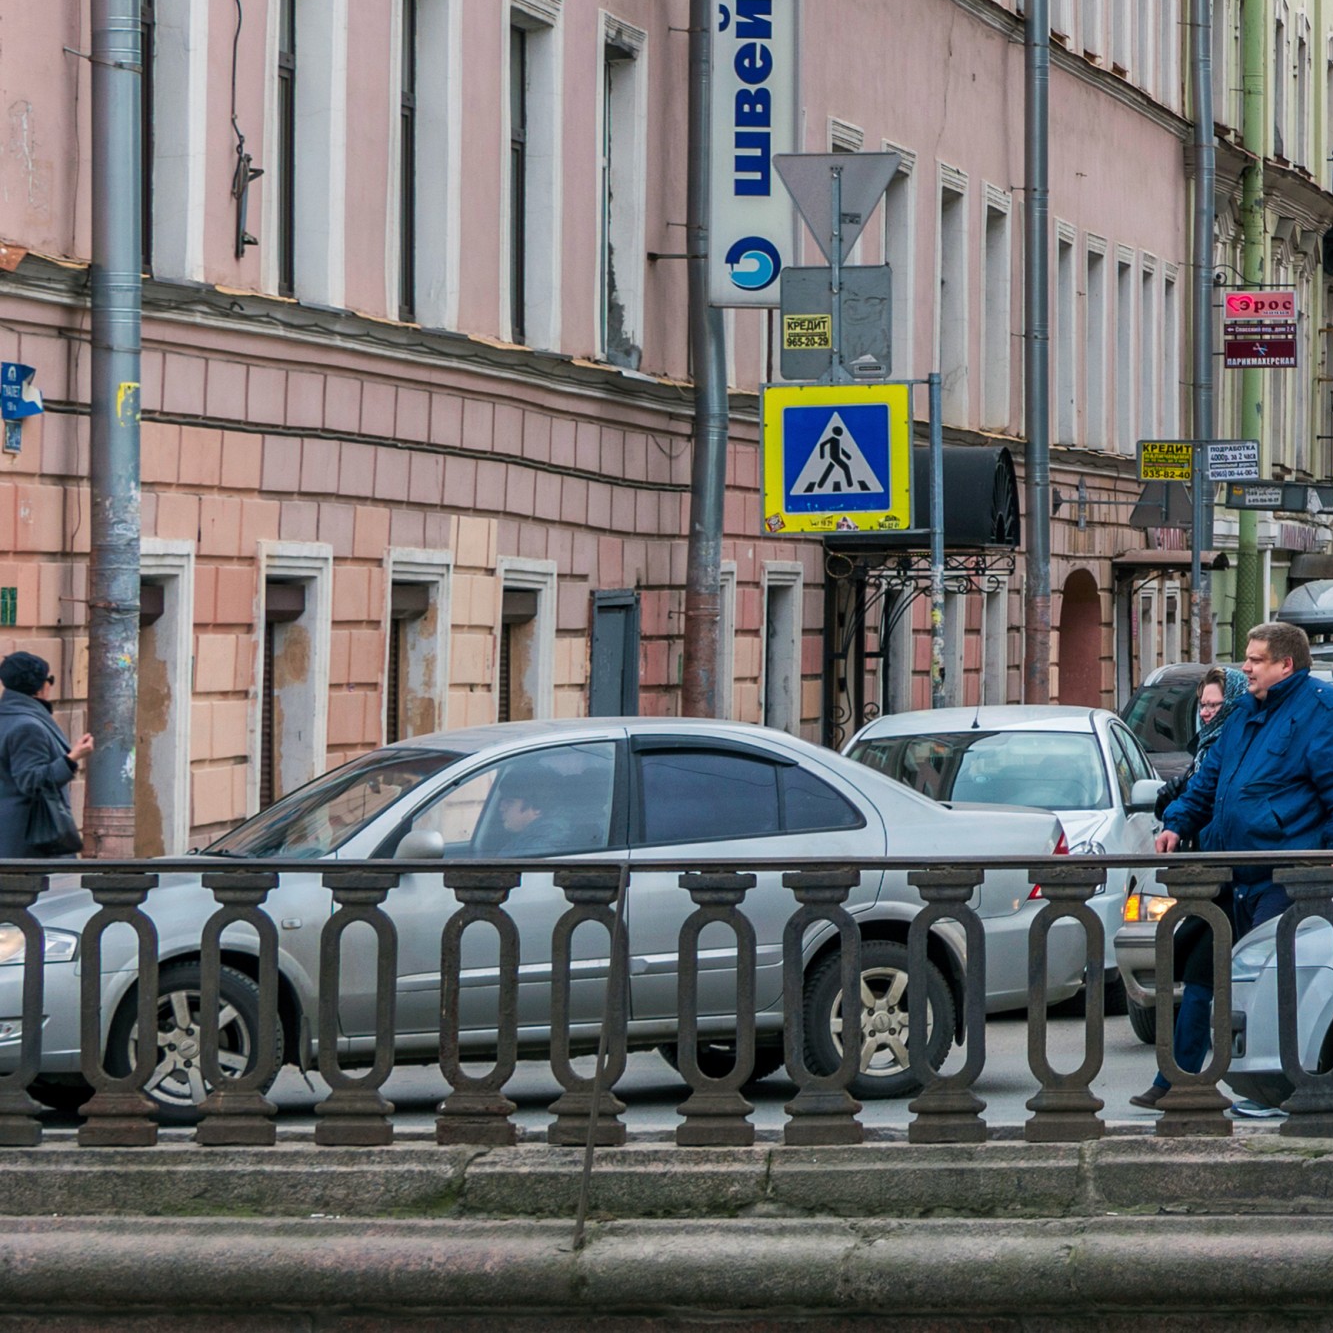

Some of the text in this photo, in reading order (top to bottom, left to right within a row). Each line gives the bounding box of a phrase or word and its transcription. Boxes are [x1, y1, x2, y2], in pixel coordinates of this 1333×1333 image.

[787, 320, 828, 331] КРЕДИТ
[787, 337, 829, 347] 965-20-29
[1226, 357, 1296, 366] ПАРИКМАХЕРСКАЯ
[1142, 444, 1191, 453] КРЕДИТ
[1210, 445, 1255, 453] ПОДРАБОТКА
[1143, 471, 1191, 479] 935-82-40
